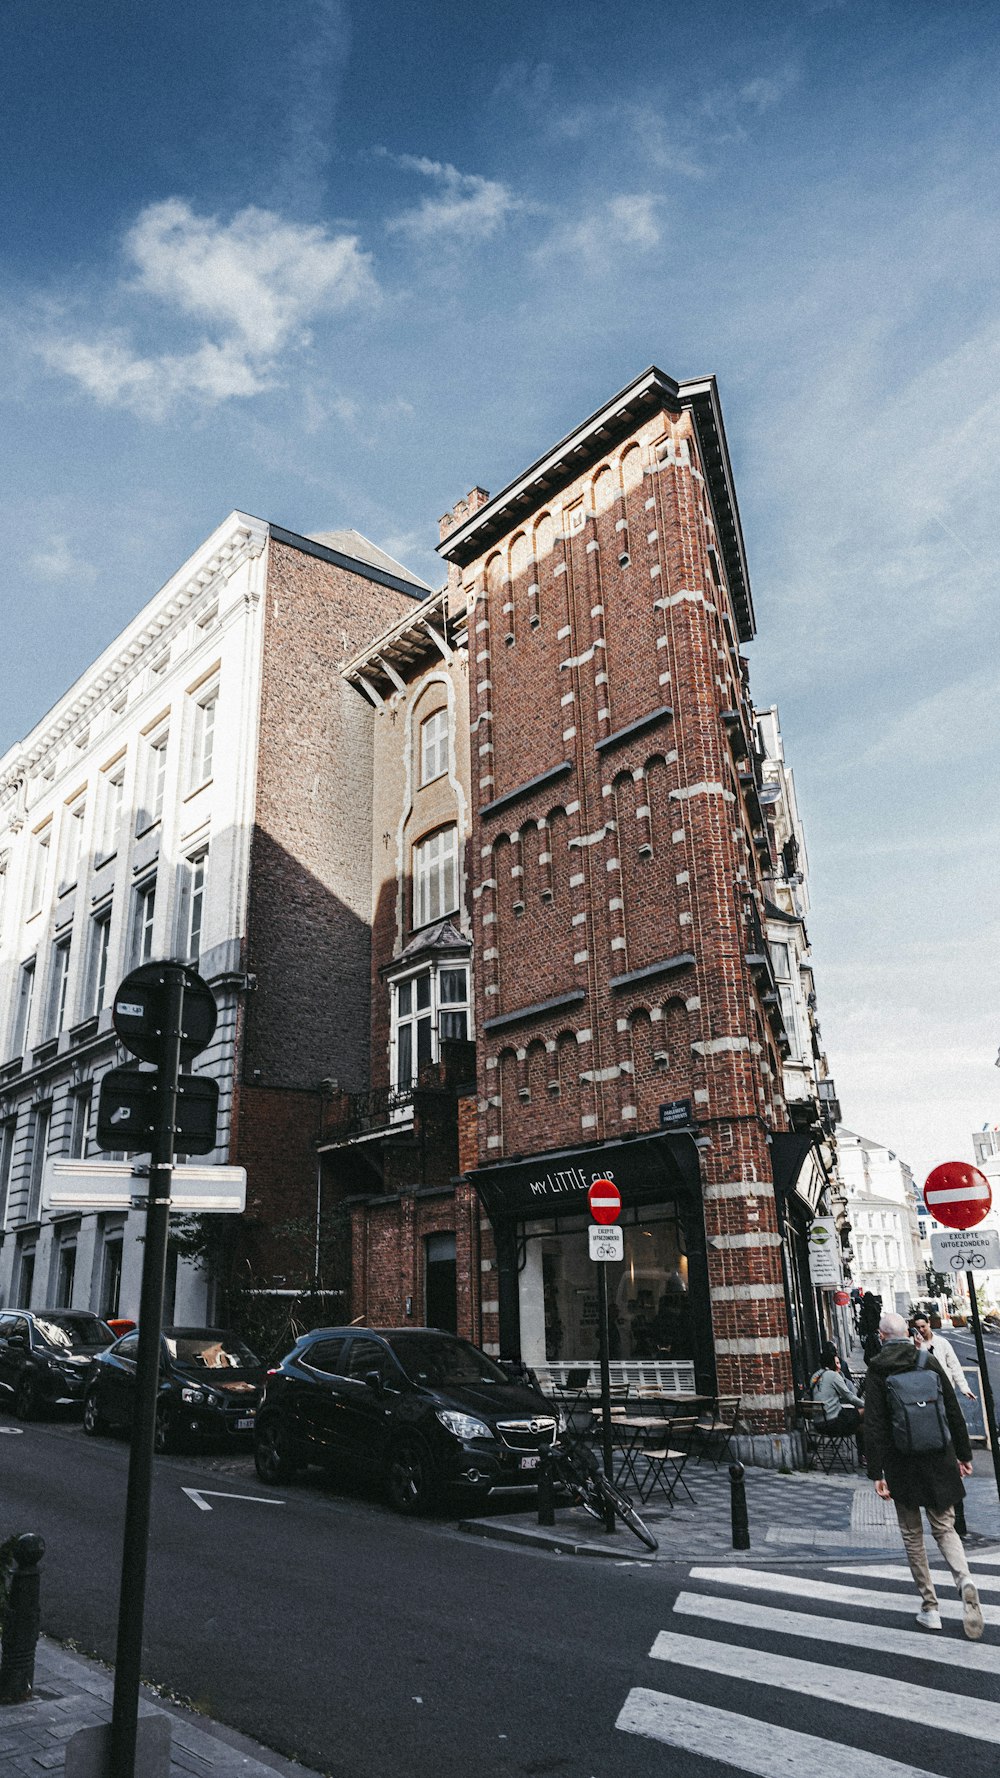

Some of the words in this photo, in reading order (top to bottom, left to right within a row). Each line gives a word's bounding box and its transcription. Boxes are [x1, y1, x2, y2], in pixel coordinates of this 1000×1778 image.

[529, 1181, 547, 1195] MY
[949, 1232, 979, 1240] EXCEPTE
[940, 1239, 990, 1249] UITGEZONDERD
